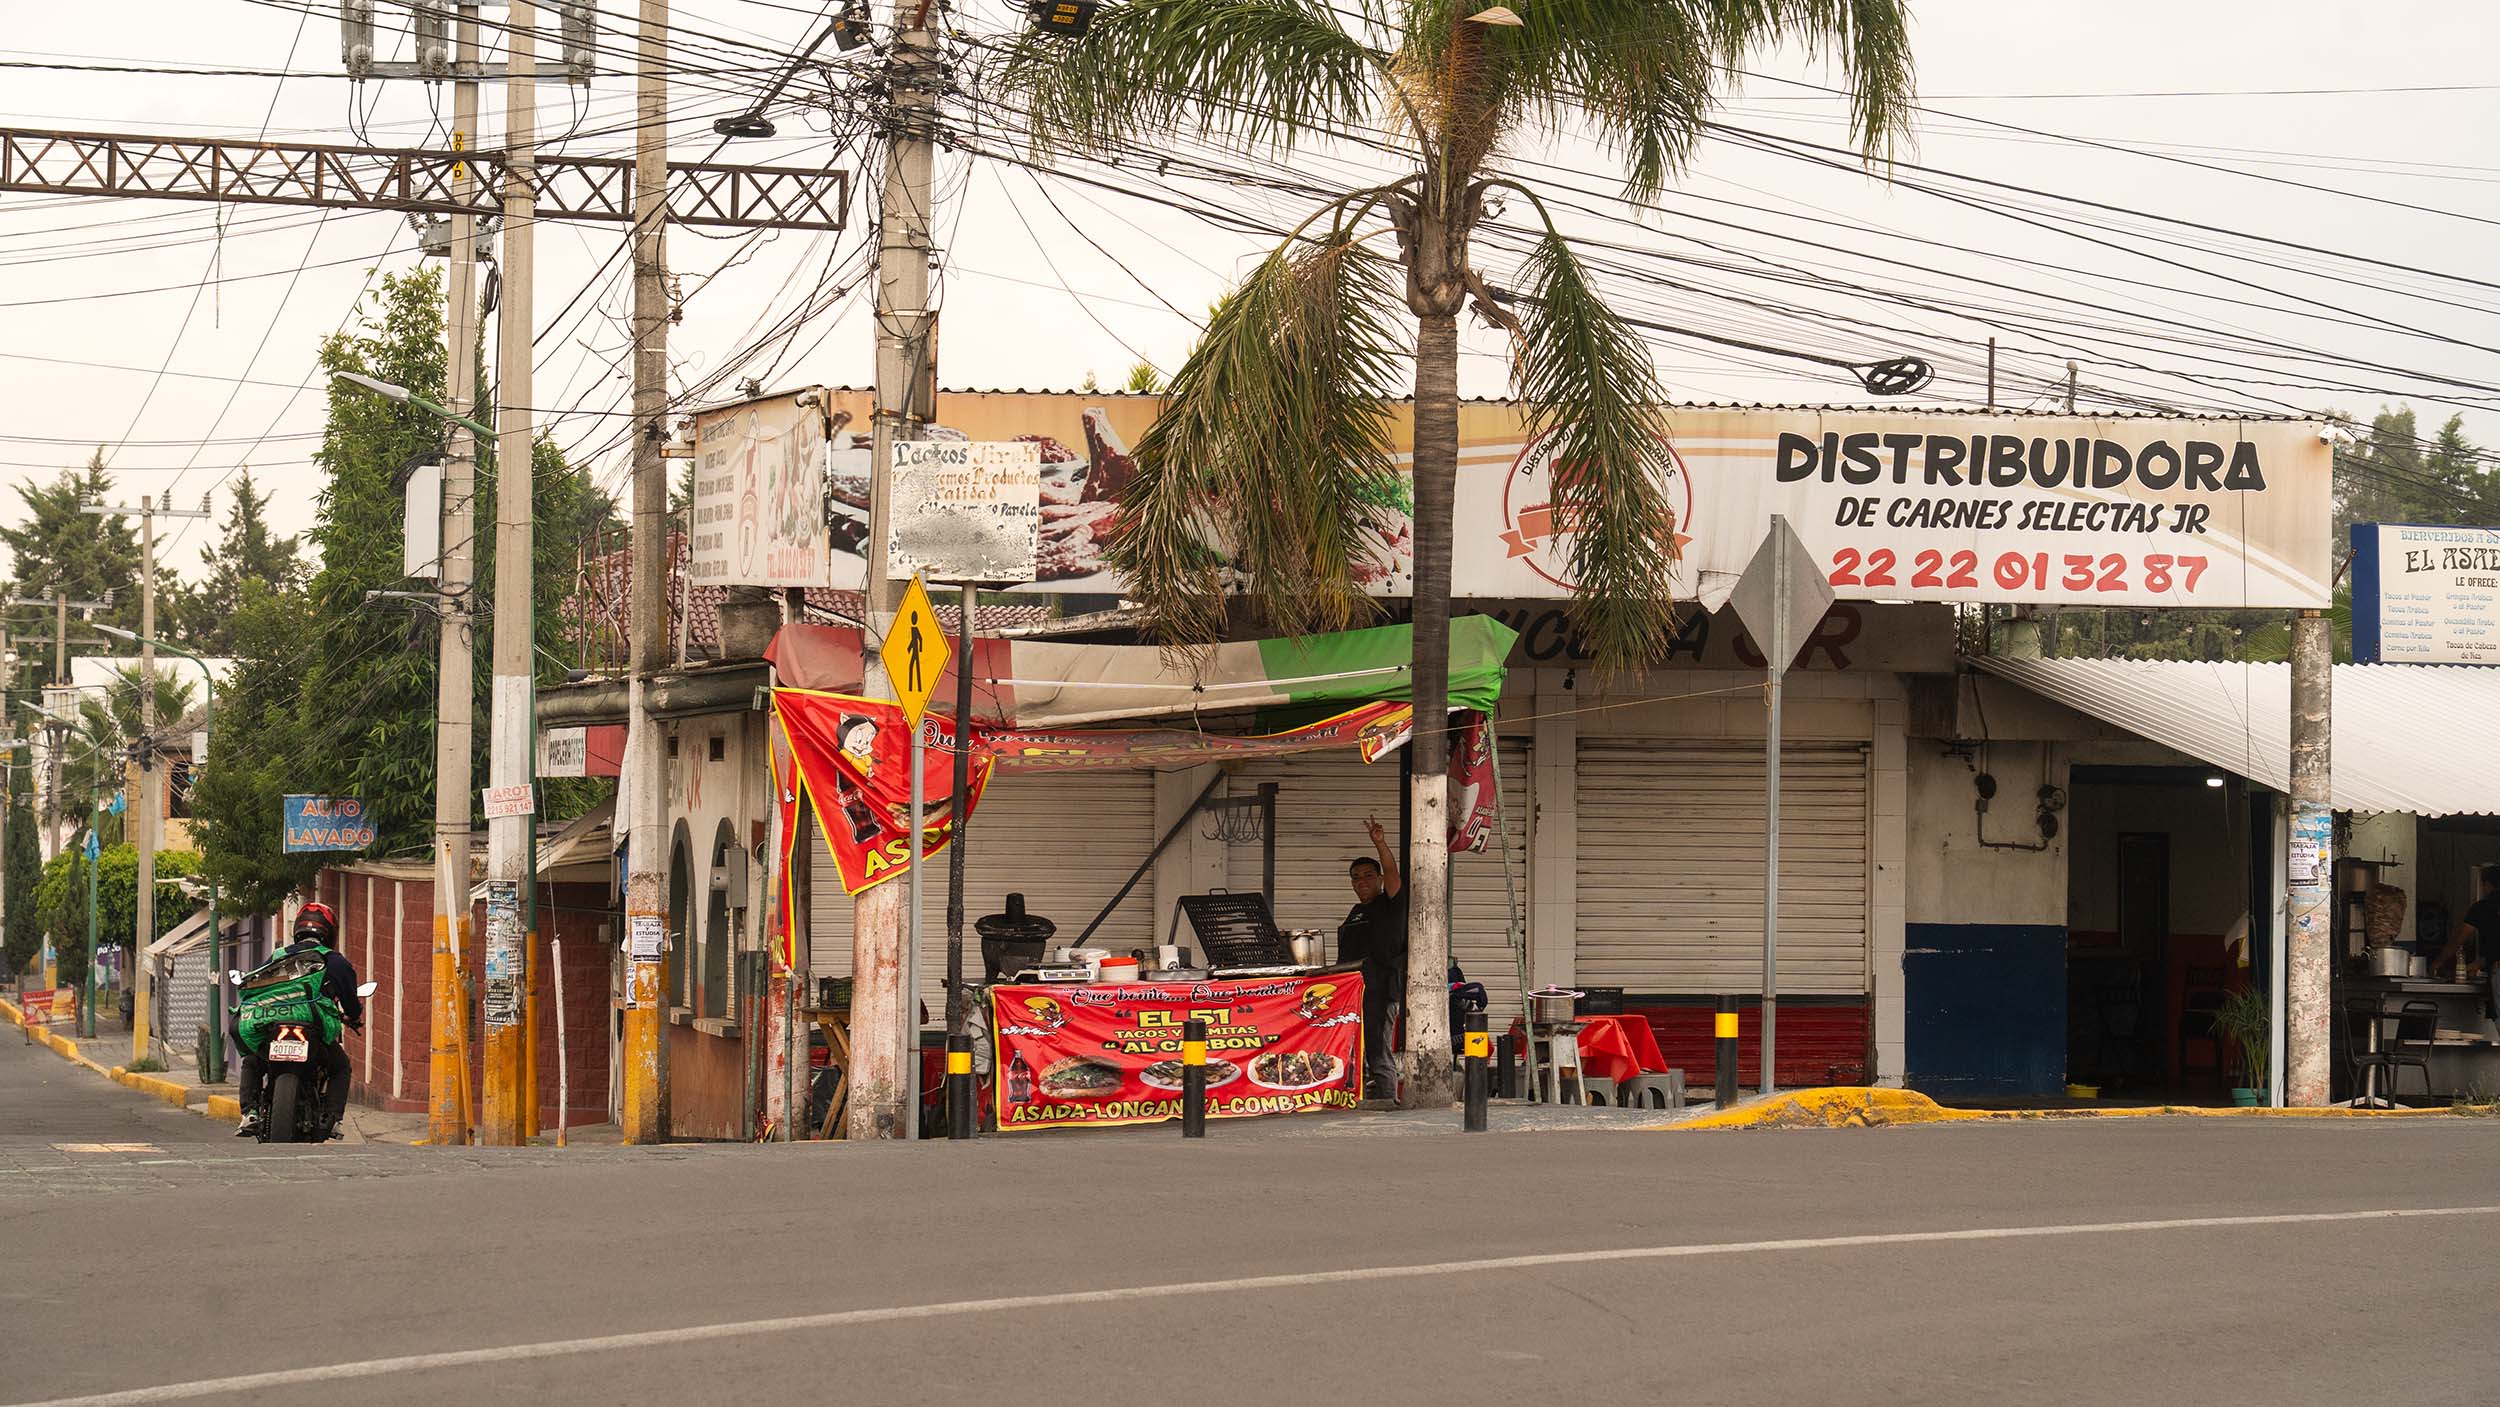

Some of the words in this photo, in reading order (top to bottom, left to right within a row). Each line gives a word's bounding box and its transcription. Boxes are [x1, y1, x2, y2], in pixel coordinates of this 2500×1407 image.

[1776, 432, 2267, 492] DISTRIBUIDORA
[1835, 497, 1878, 528] DE
[1879, 497, 2012, 531] CARNES
[2016, 500, 2161, 534] SELECTAS
[2165, 503, 2209, 535] JR
[1828, 547, 1897, 588] 22
[1911, 550, 1978, 589] 22
[1993, 552, 2049, 592] 01
[2062, 553, 2128, 593] 32
[2143, 554, 2208, 593] 87
[2405, 549, 2435, 573] EL
[2455, 577, 2465, 587] LE
[2468, 577, 2498, 588] OFRECE:
[301, 799, 361, 817] AUTO
[288, 828, 374, 846] LAVADO
[253, 1005, 294, 1020] Uber
[1115, 1030, 1168, 1039] TACOS
[1171, 1029, 1182, 1038] Y
[1205, 1026, 1257, 1036] MITAS
